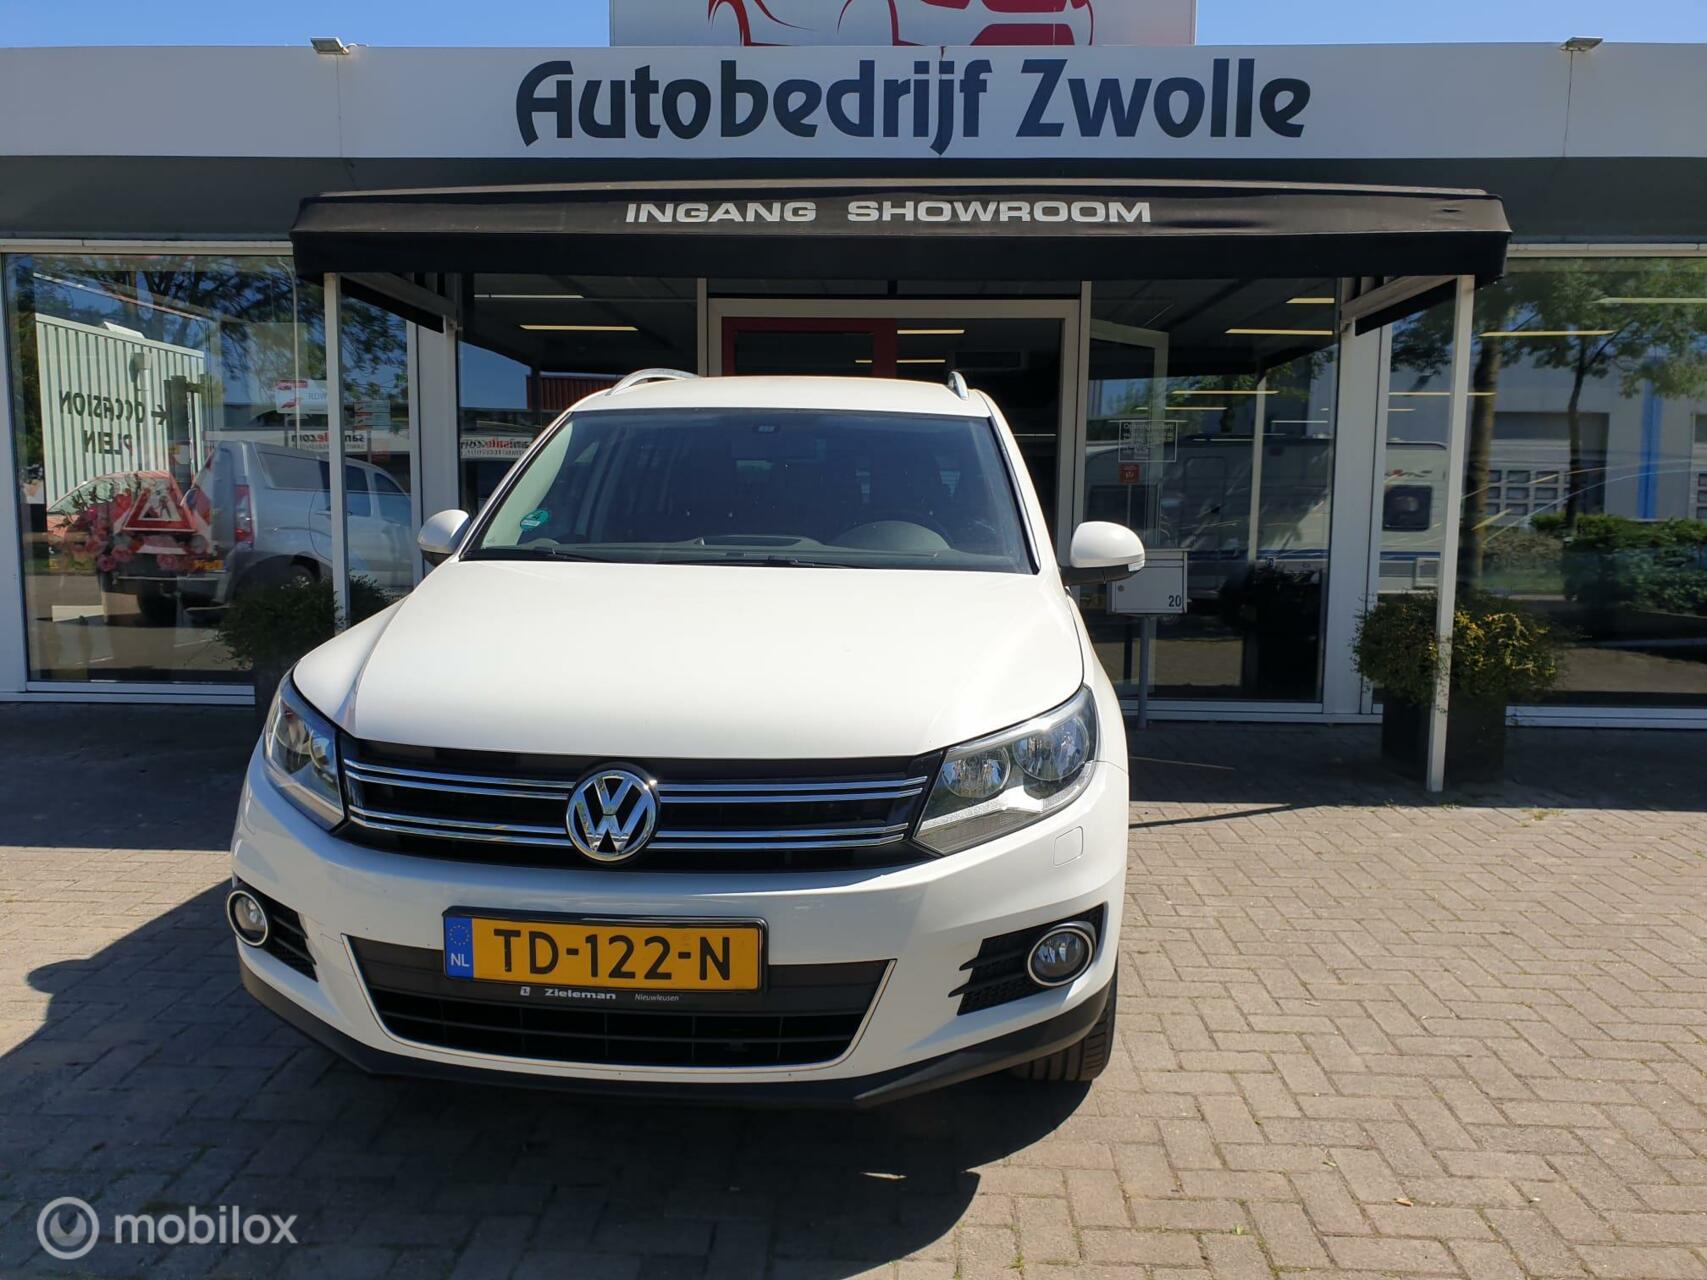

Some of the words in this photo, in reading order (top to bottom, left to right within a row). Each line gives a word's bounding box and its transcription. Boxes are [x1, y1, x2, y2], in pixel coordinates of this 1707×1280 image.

[516, 59, 989, 157] Autobedrijf
[1016, 58, 1311, 139] Zwolle
[625, 203, 817, 224] INGANG
[846, 201, 1152, 223] SHOWROOM
[1168, 595, 1182, 607] 20
[450, 952, 470, 968] NL
[493, 928, 731, 981] TD-122-N
[544, 988, 616, 1000] Zieleman
